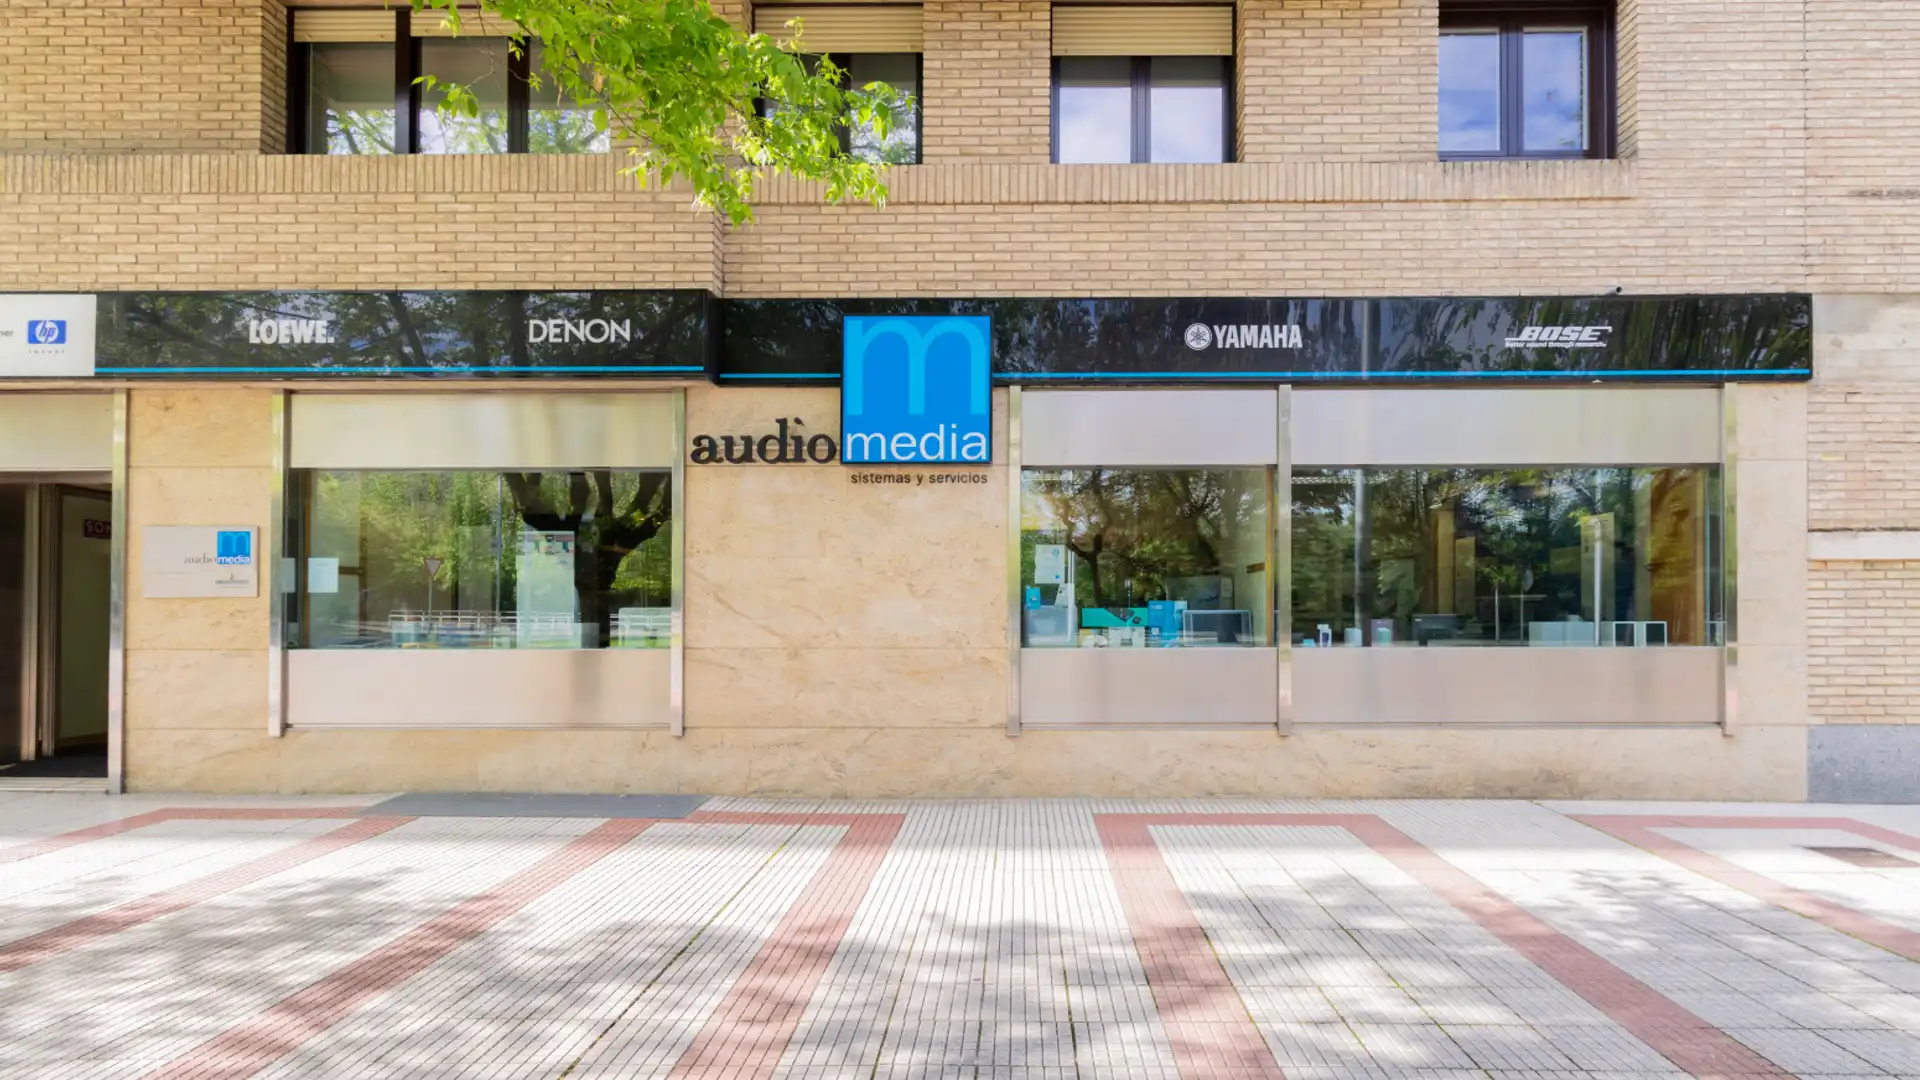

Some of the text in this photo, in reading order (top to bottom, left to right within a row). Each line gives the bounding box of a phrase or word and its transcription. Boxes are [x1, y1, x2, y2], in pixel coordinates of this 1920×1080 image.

[527, 317, 632, 344] DENON
[1213, 324, 1303, 349] YAMAHA
[1504, 325, 1613, 341] BOSE
[846, 423, 988, 462] media
[850, 472, 988, 486] sistemas y servicios
[218, 555, 250, 565] media
